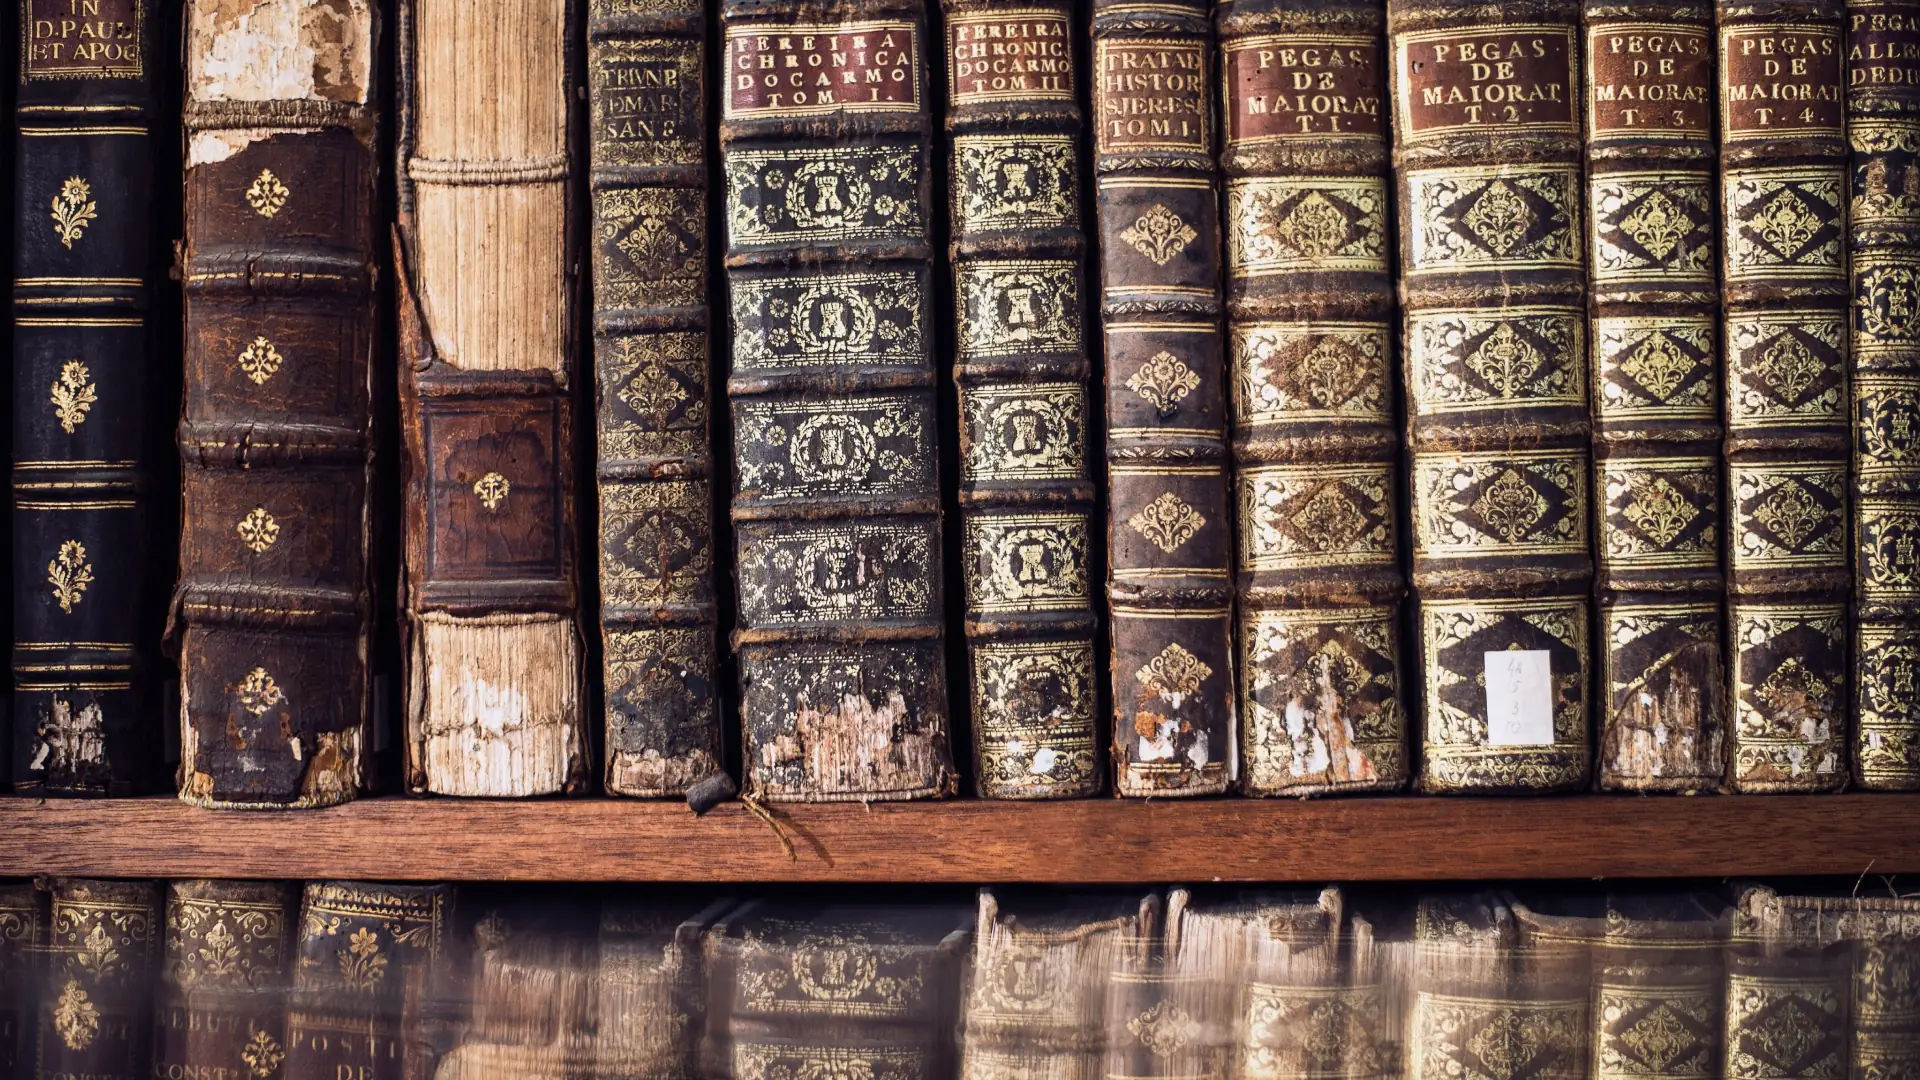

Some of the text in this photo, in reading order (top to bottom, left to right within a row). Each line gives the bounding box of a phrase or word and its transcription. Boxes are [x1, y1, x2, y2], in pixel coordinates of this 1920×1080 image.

[70, 0, 98, 17] IN
[956, 23, 1065, 42] PEREIRA
[1850, 14, 1920, 33] PEGA
[33, 43, 65, 60] ET
[735, 33, 896, 51] PEREIRA
[1610, 35, 1701, 56] PEGAS
[1742, 37, 1833, 55] PEGAS
[737, 51, 909, 70] CHRONICA
[1633, 58, 1675, 77] DE
[1764, 58, 1808, 76] DE
[1471, 61, 1516, 82] DE
[1291, 72, 1336, 91] DE
